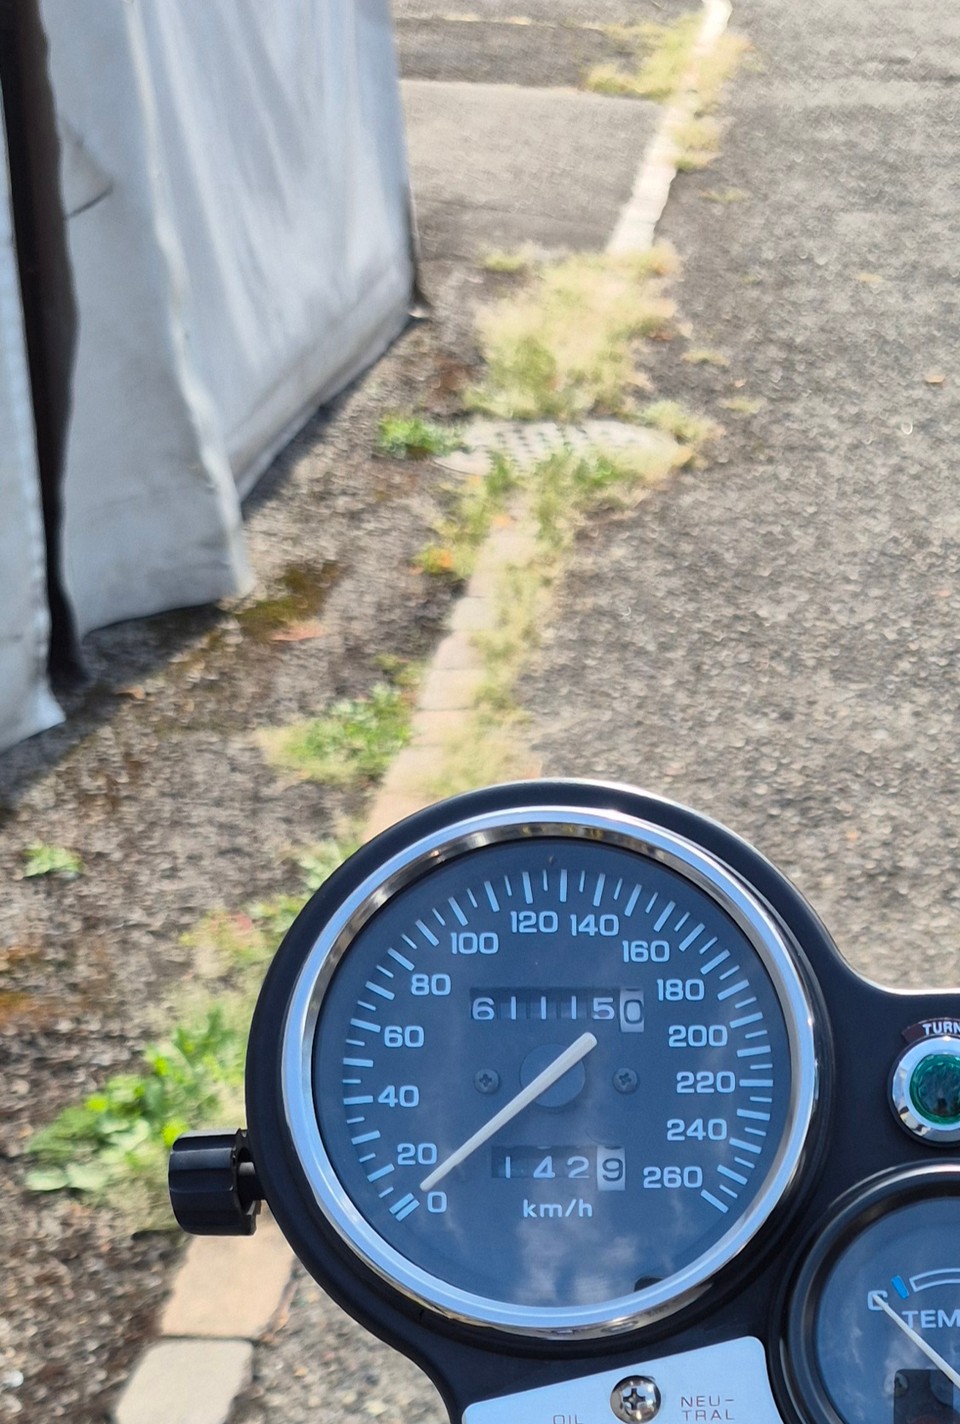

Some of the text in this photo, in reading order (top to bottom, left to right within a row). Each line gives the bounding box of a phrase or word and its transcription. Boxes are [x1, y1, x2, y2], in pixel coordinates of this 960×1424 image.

[511, 911, 558, 933] 120
[571, 914, 619, 936] 140
[451, 932, 498, 954] 100
[623, 940, 670, 962] 160
[411, 974, 451, 996] 80
[657, 979, 704, 1001] 180
[384, 1026, 424, 1047] 60
[668, 1025, 727, 1047] 200
[676, 1071, 735, 1093] 220
[378, 1086, 419, 1108] 40
[667, 1119, 727, 1140] 240
[397, 1143, 437, 1165] 20
[643, 1166, 702, 1188] 260
[428, 1192, 447, 1213] 0
[523, 1199, 592, 1218] km/h
[868, 1290, 888, 1311] C
[681, 1395, 734, 1407] NEU-
[682, 1409, 734, 1421] TRAL
